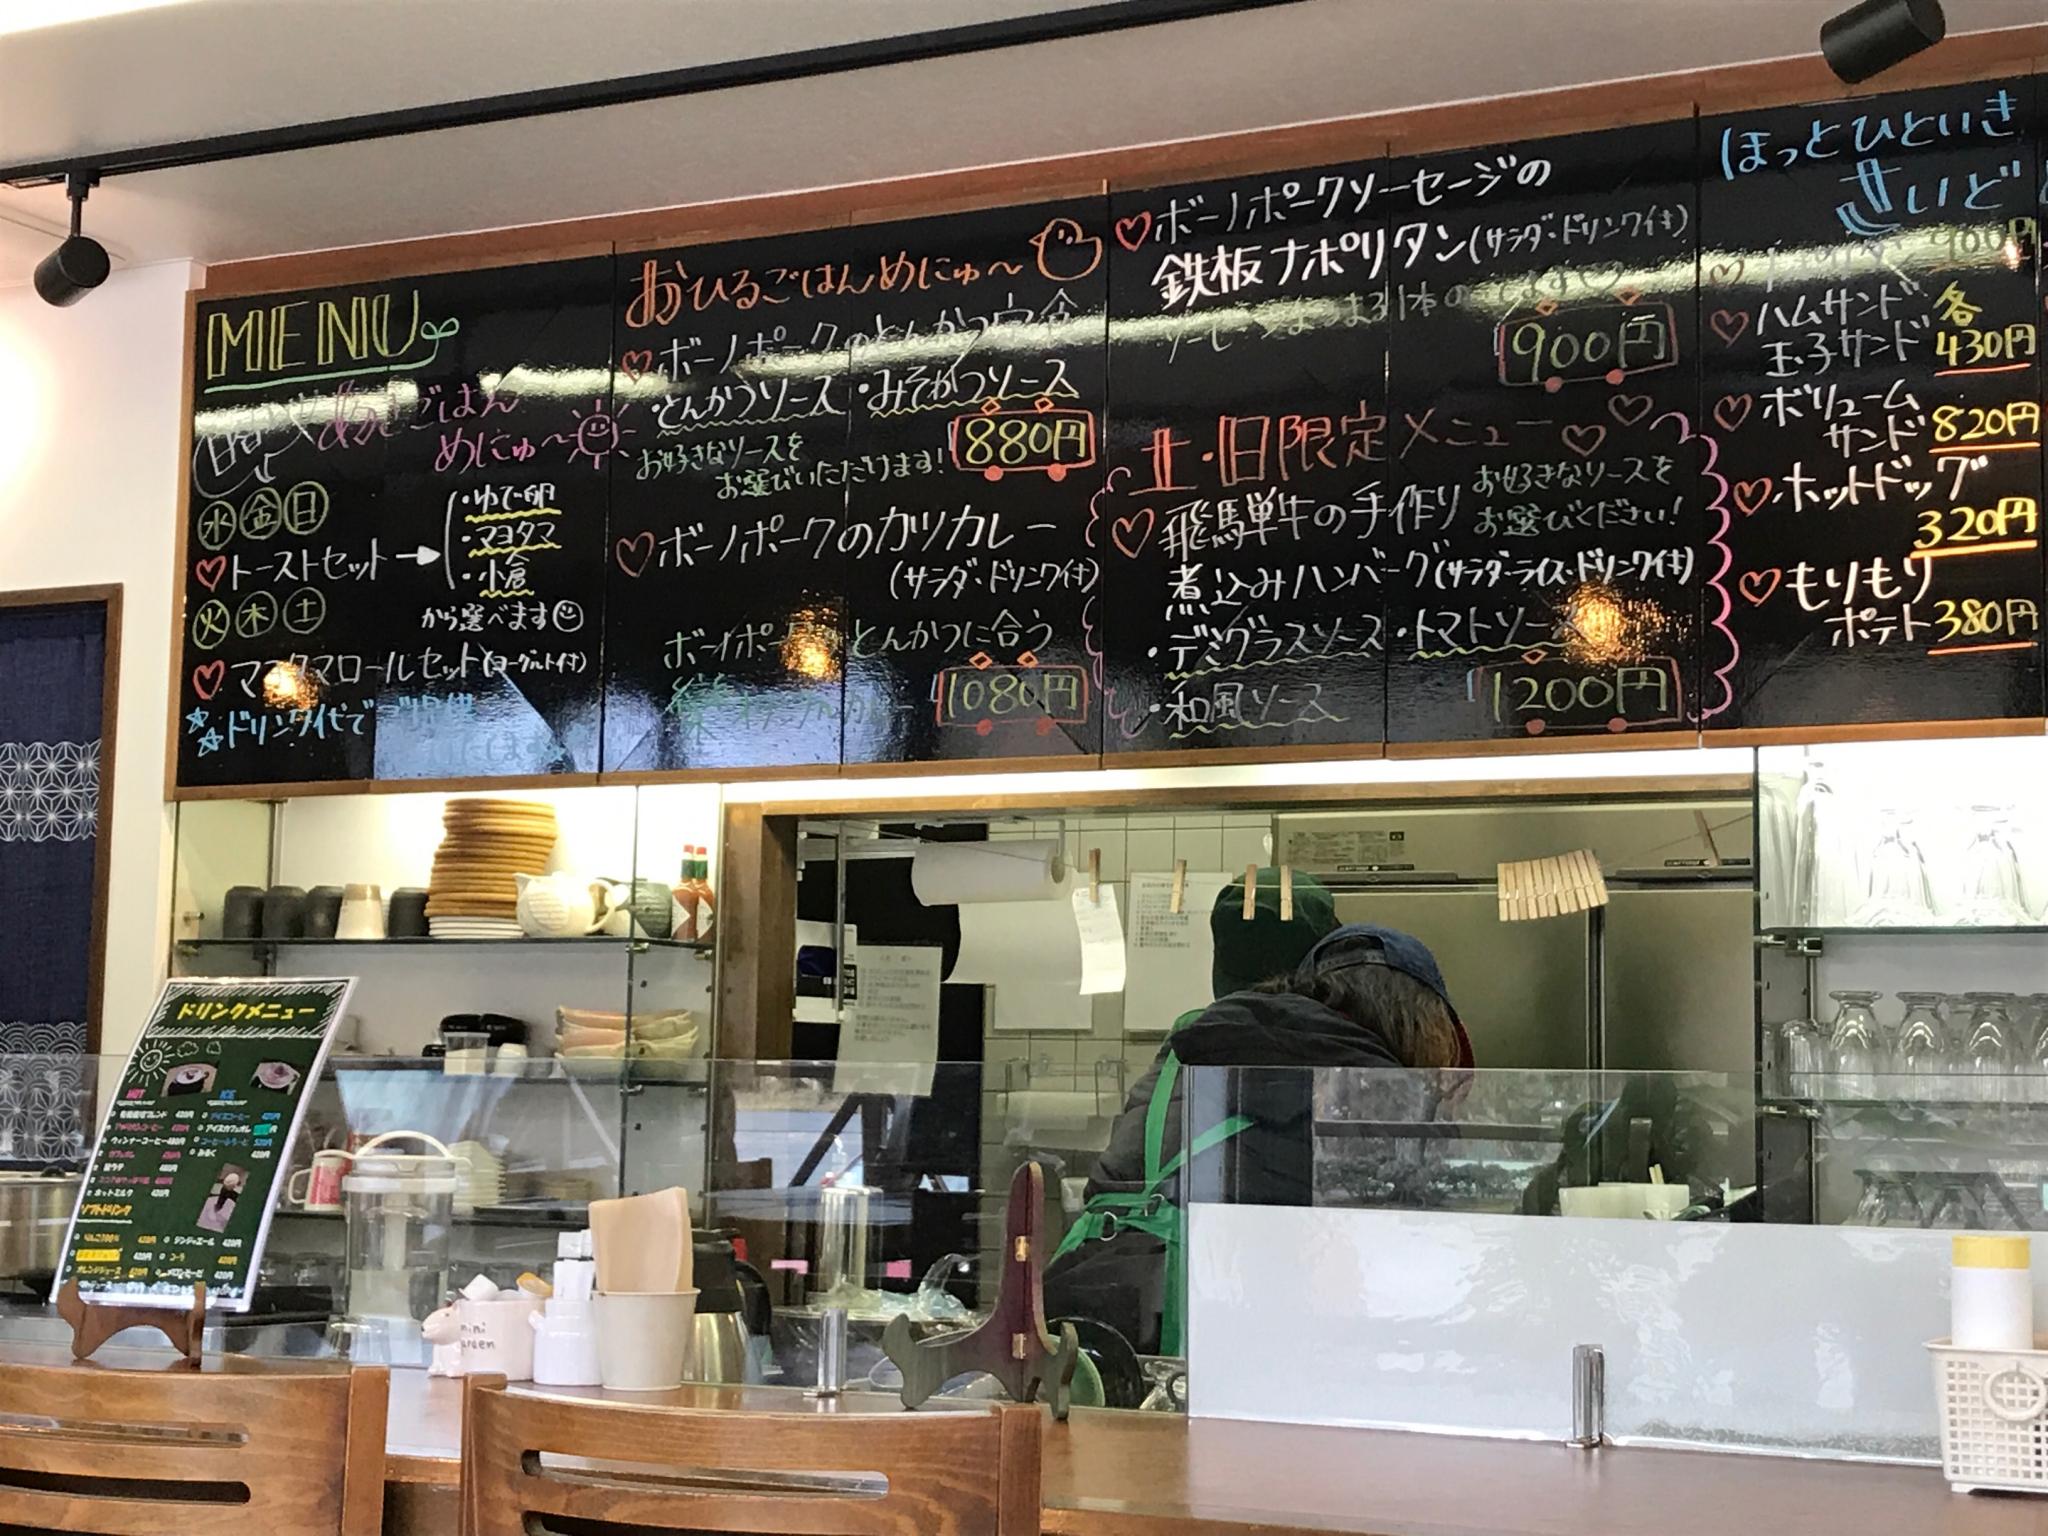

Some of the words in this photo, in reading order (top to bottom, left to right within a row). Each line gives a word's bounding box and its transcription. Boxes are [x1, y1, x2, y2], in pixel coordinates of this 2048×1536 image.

[1721, 89, 2018, 181] ほっとひといき
[1154, 155, 1552, 245] ボーノポークソーセージの
[207, 289, 419, 381] MENU
[1757, 281, 1922, 337] ハムサンド
[1933, 281, 1983, 327] 各
[1512, 314, 1667, 383] 900円
[1761, 315, 1930, 377] 玉子サンド
[1935, 323, 2036, 367] 430円
[1760, 379, 1922, 427] ボリューム
[637, 431, 804, 481] お好きなソースを
[965, 415, 1088, 464] 880円
[1823, 414, 1926, 458] サンド
[1931, 402, 2041, 442] 820円
[473, 483, 556, 512] ゆで卵
[1473, 454, 1676, 498] お好きなソースを
[1772, 453, 1989, 513] ホットドッグ
[479, 521, 557, 549] マヨタマ
[659, 504, 1058, 568] ボーノポークのカツカレー
[1912, 496, 2038, 549] 320円
[231, 538, 388, 591] トーストセット
[477, 551, 531, 591] 小倉
[1785, 555, 1933, 612] もりもり
[421, 600, 549, 632] から選べます
[1824, 602, 1932, 647] ポテト
[1933, 599, 2039, 643] 380円
[949, 672, 1078, 721] 1080円
[1165, 682, 1338, 728] 和風ソース
[1493, 667, 1667, 723] 1200円
[176, 1002, 316, 1021] ドリンクメニュー
